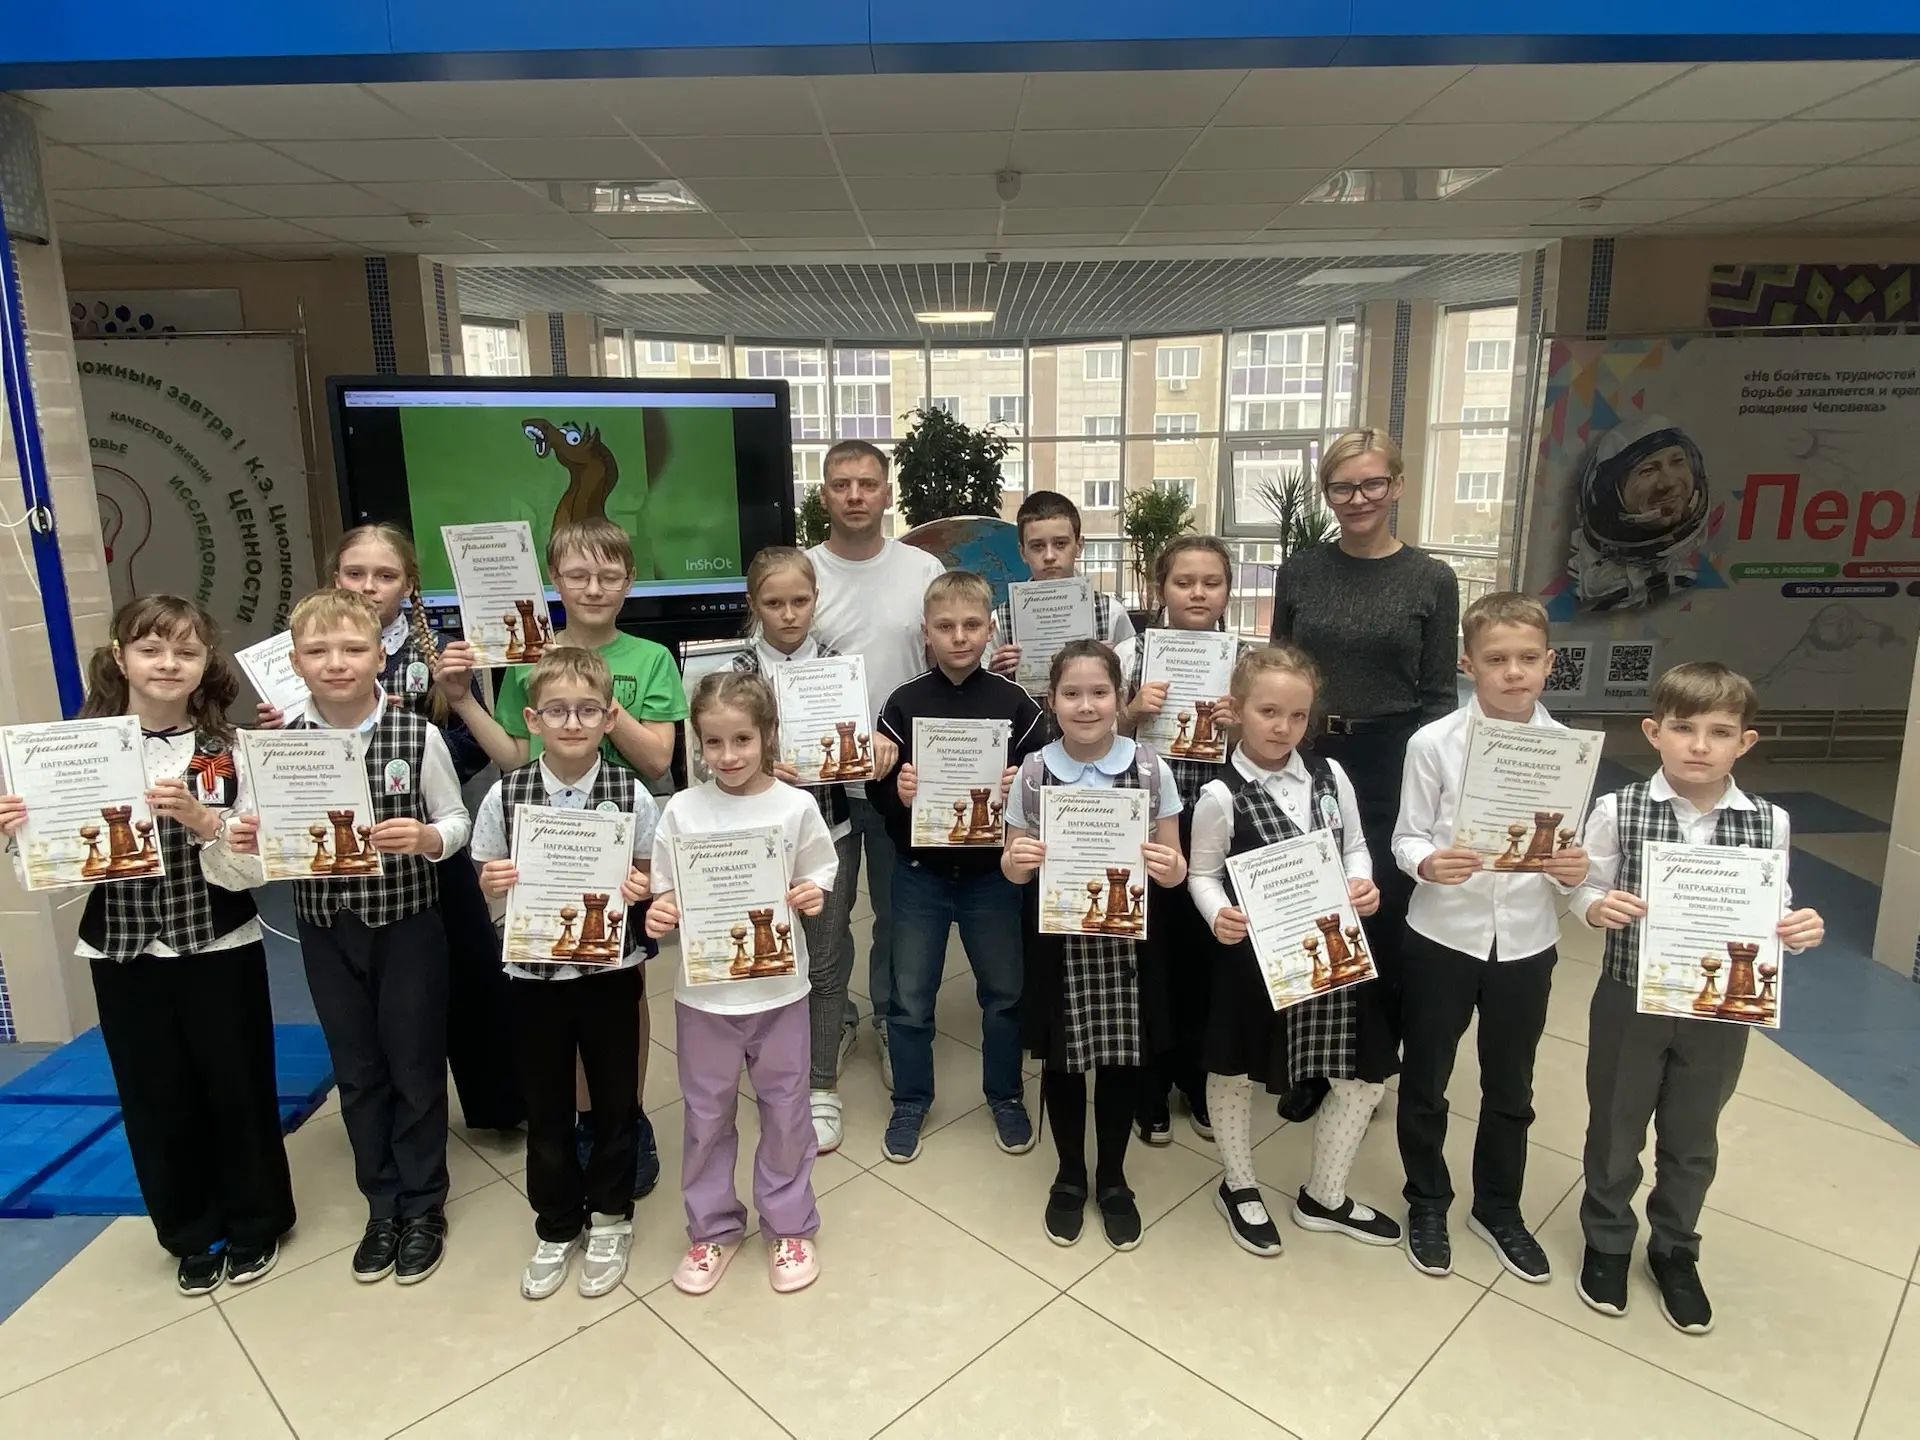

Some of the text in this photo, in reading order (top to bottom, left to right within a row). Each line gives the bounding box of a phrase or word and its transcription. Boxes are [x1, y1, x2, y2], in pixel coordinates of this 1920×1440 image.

[1773, 369, 1831, 382] бойтесь
[1835, 368, 1916, 383] трудностей
[1741, 386, 1792, 400] борьбе
[1738, 403, 1808, 416] рождение
[89, 437, 128, 454] ОВЬЕ
[110, 411, 212, 483] КАЧЕСТВО ЖИЗНИ
[169, 475, 216, 607] ИССЛЕДОВАН
[228, 489, 263, 623] ЦЕННОСТИ
[543, 843, 602, 853] НАГРАЖДАЕТСЯ
[1662, 864, 1740, 882] грамота
[1677, 883, 1746, 895] НАГРАЖДАЕТСЯ
